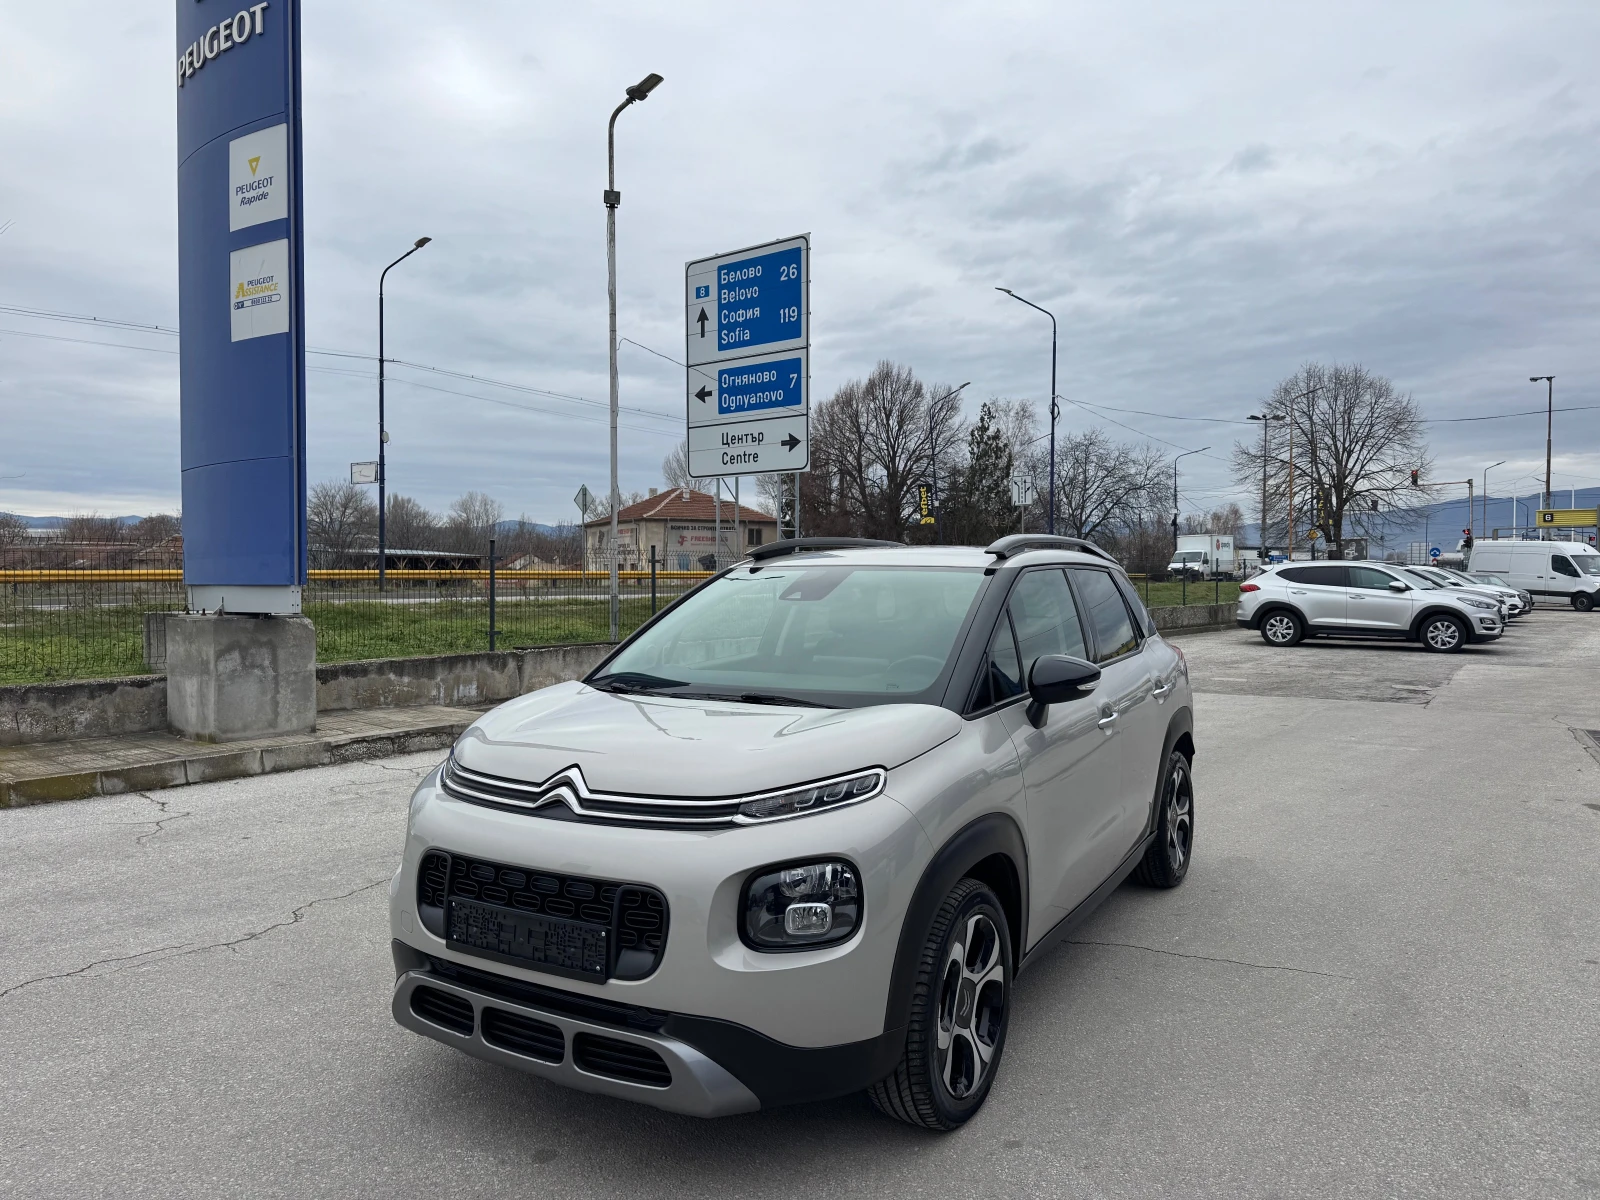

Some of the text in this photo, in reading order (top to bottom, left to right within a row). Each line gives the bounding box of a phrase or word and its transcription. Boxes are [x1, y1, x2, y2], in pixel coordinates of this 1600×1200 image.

[178, 1, 269, 88] PEUGEOT
[235, 175, 274, 196] PEUGEOT
[239, 191, 269, 207] Rapide
[247, 275, 274, 287] PEUGEOT
[721, 263, 798, 284] Белово 26
[699, 286, 706, 297] 8
[721, 286, 759, 304] Belovo
[721, 306, 798, 324] София 119
[721, 327, 750, 344] Sofia
[721, 370, 798, 389] Огняново 7
[721, 389, 784, 410] Ognyanovo
[721, 431, 764, 448] Център
[721, 450, 759, 465] Centre
